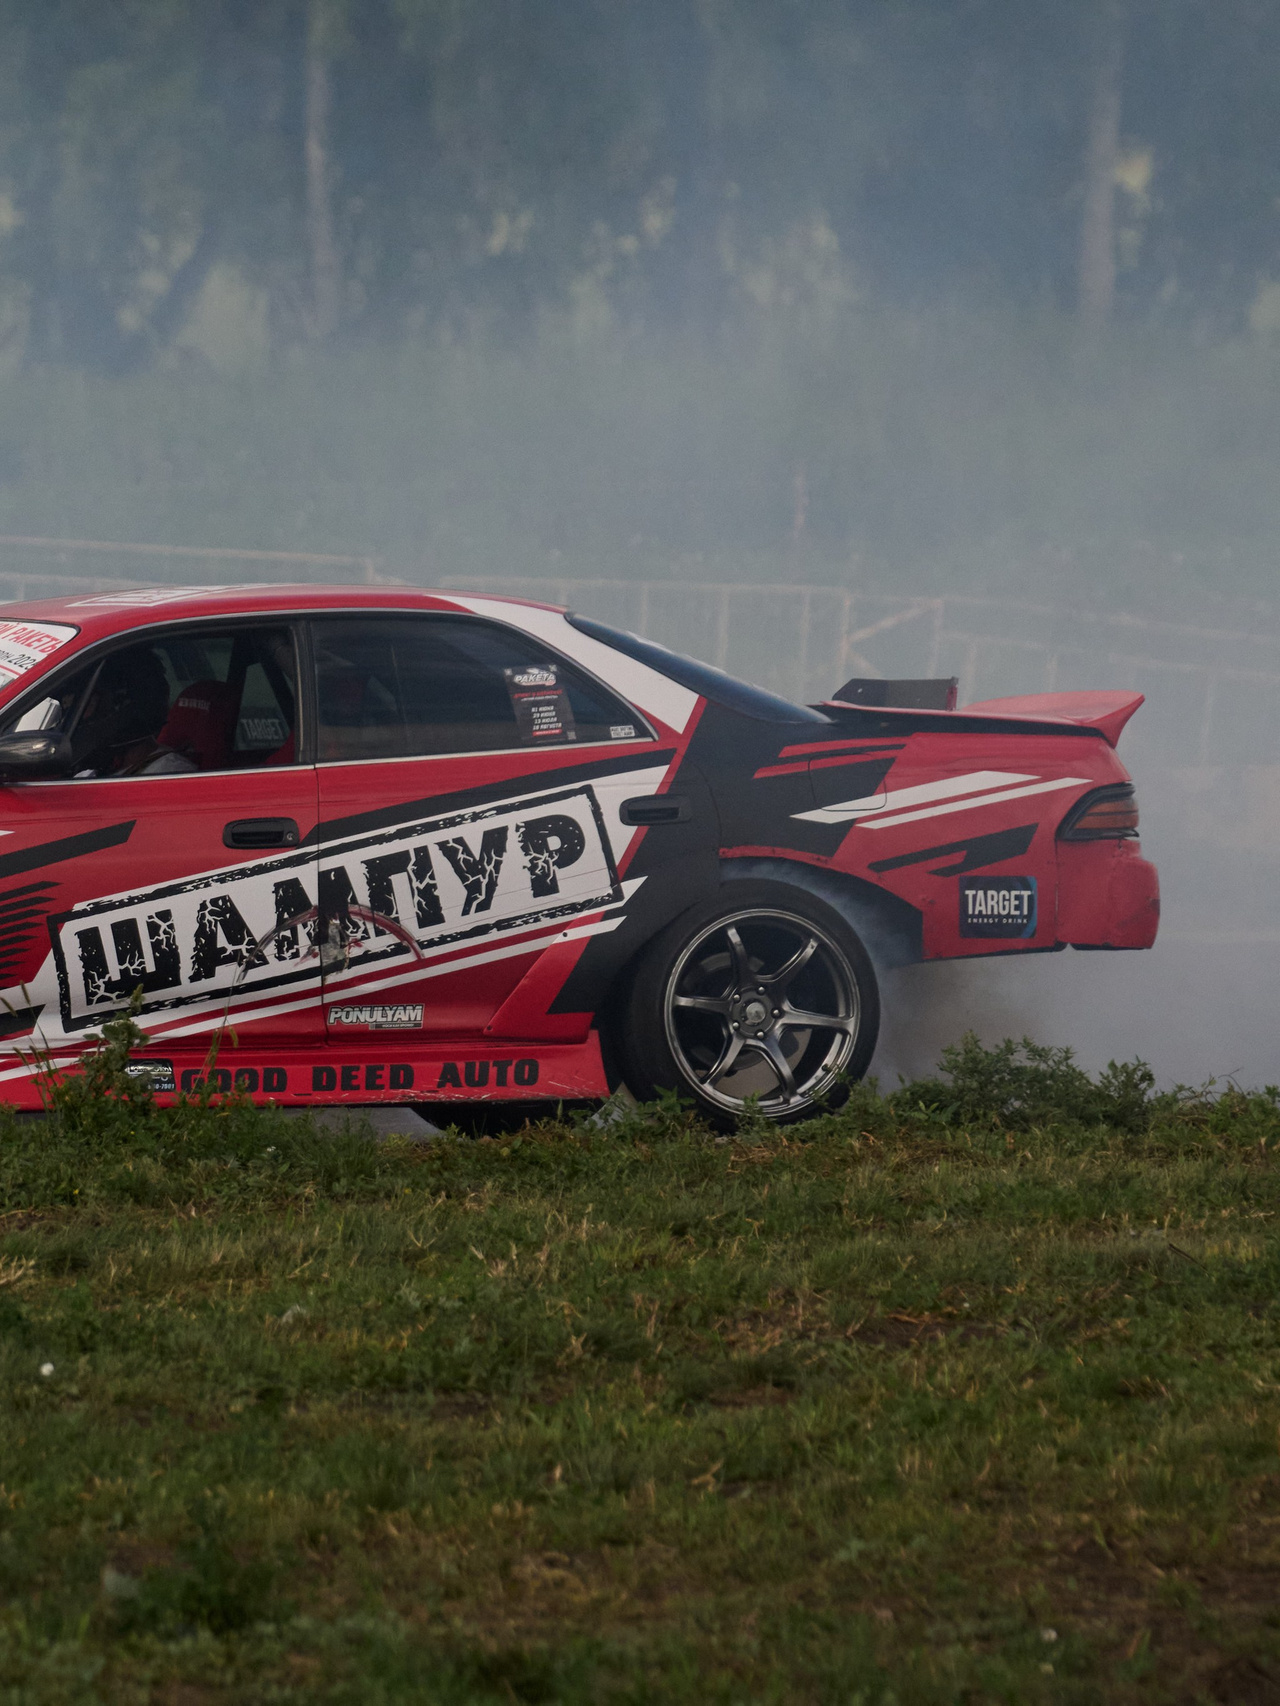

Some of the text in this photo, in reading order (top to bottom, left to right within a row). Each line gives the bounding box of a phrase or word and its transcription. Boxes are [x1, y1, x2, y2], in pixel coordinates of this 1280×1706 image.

[514, 673, 556, 683] РАКЕТА
[76, 813, 587, 1006] ШАМПУР
[964, 889, 1032, 916] TARGET
[328, 1005, 423, 1024] PONULYAM
